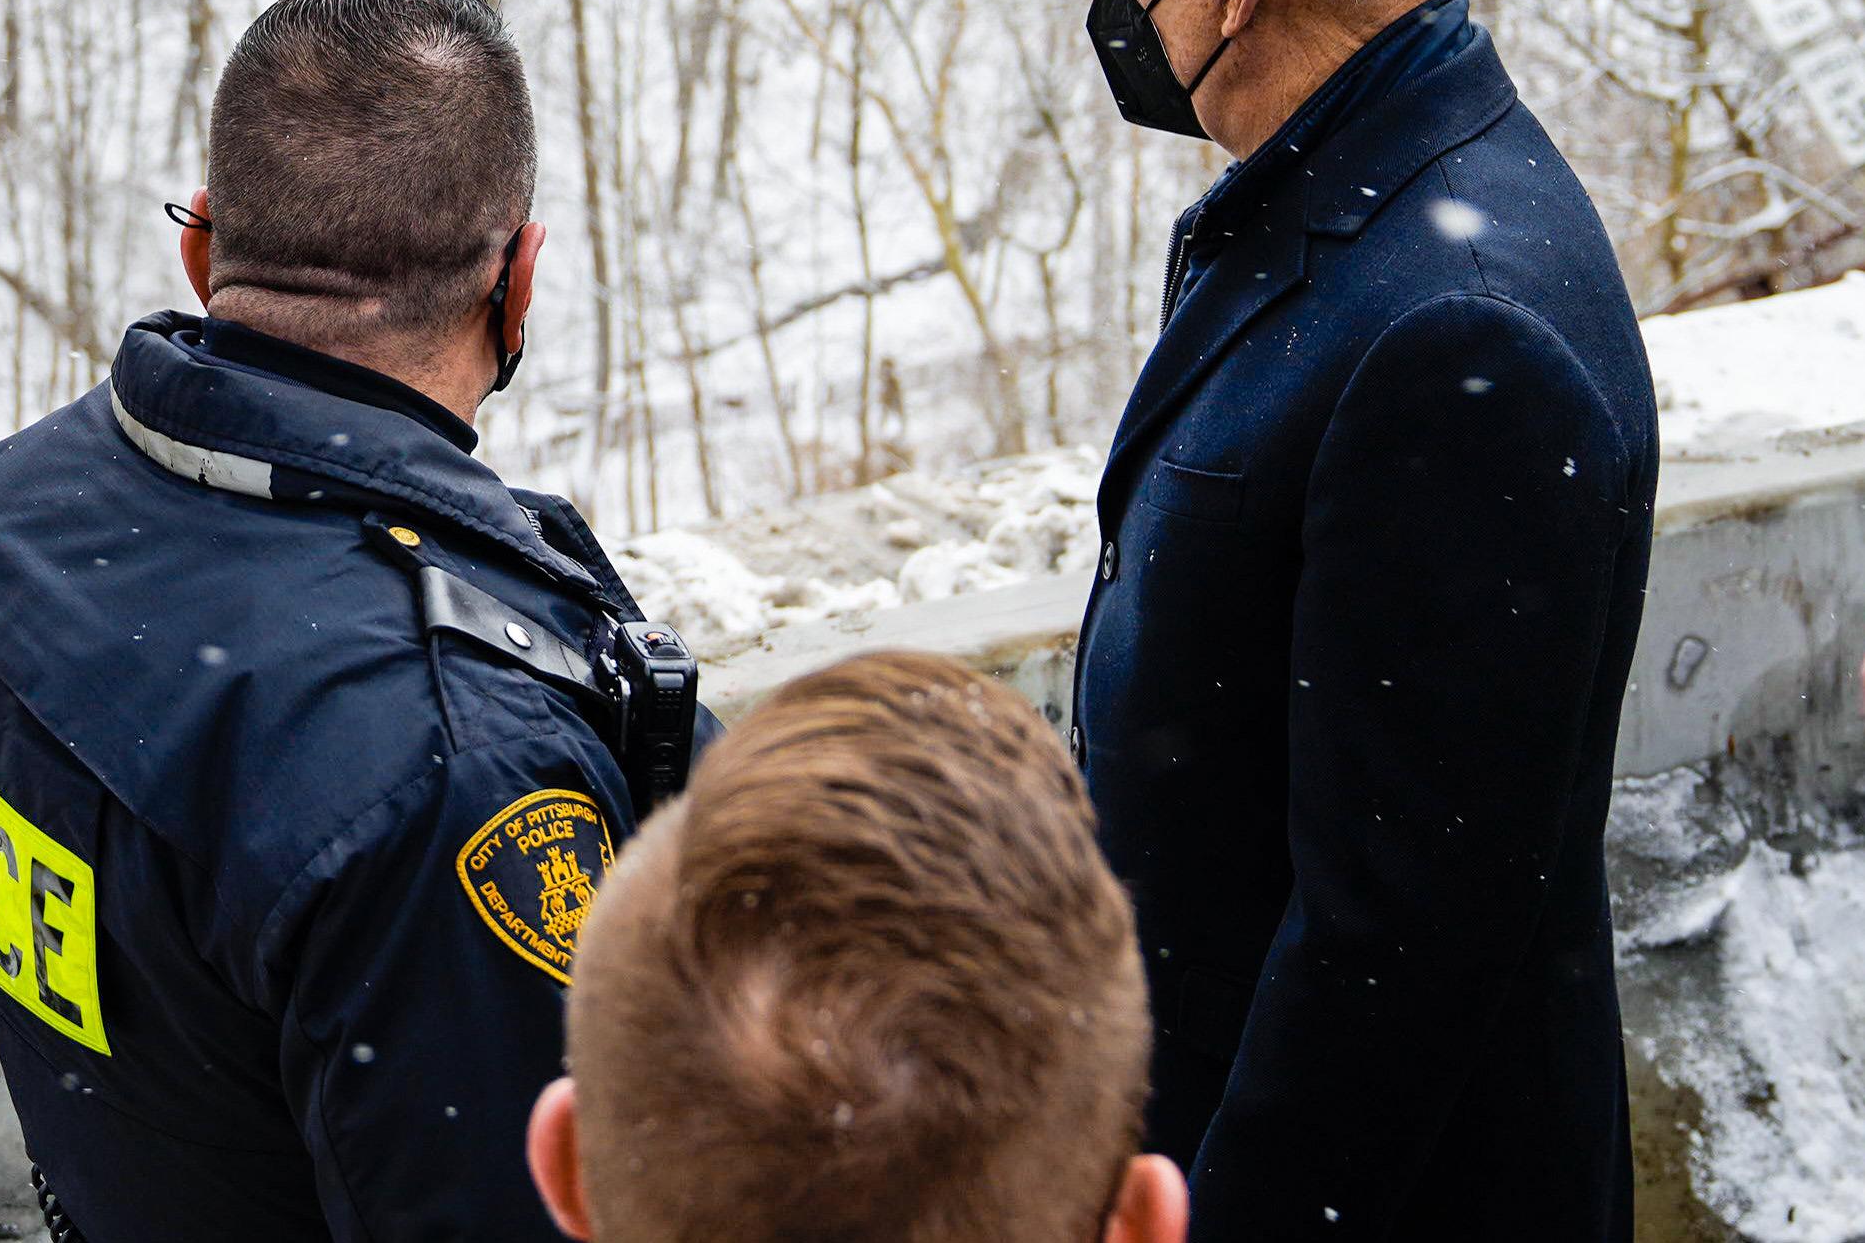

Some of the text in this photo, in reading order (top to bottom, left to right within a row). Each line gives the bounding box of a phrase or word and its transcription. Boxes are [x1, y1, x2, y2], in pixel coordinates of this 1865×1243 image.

[470, 802, 598, 872] CITY OF PITTSBURGH
[516, 819, 575, 856] POLICE
[480, 880, 574, 968] DEPARTMENT
